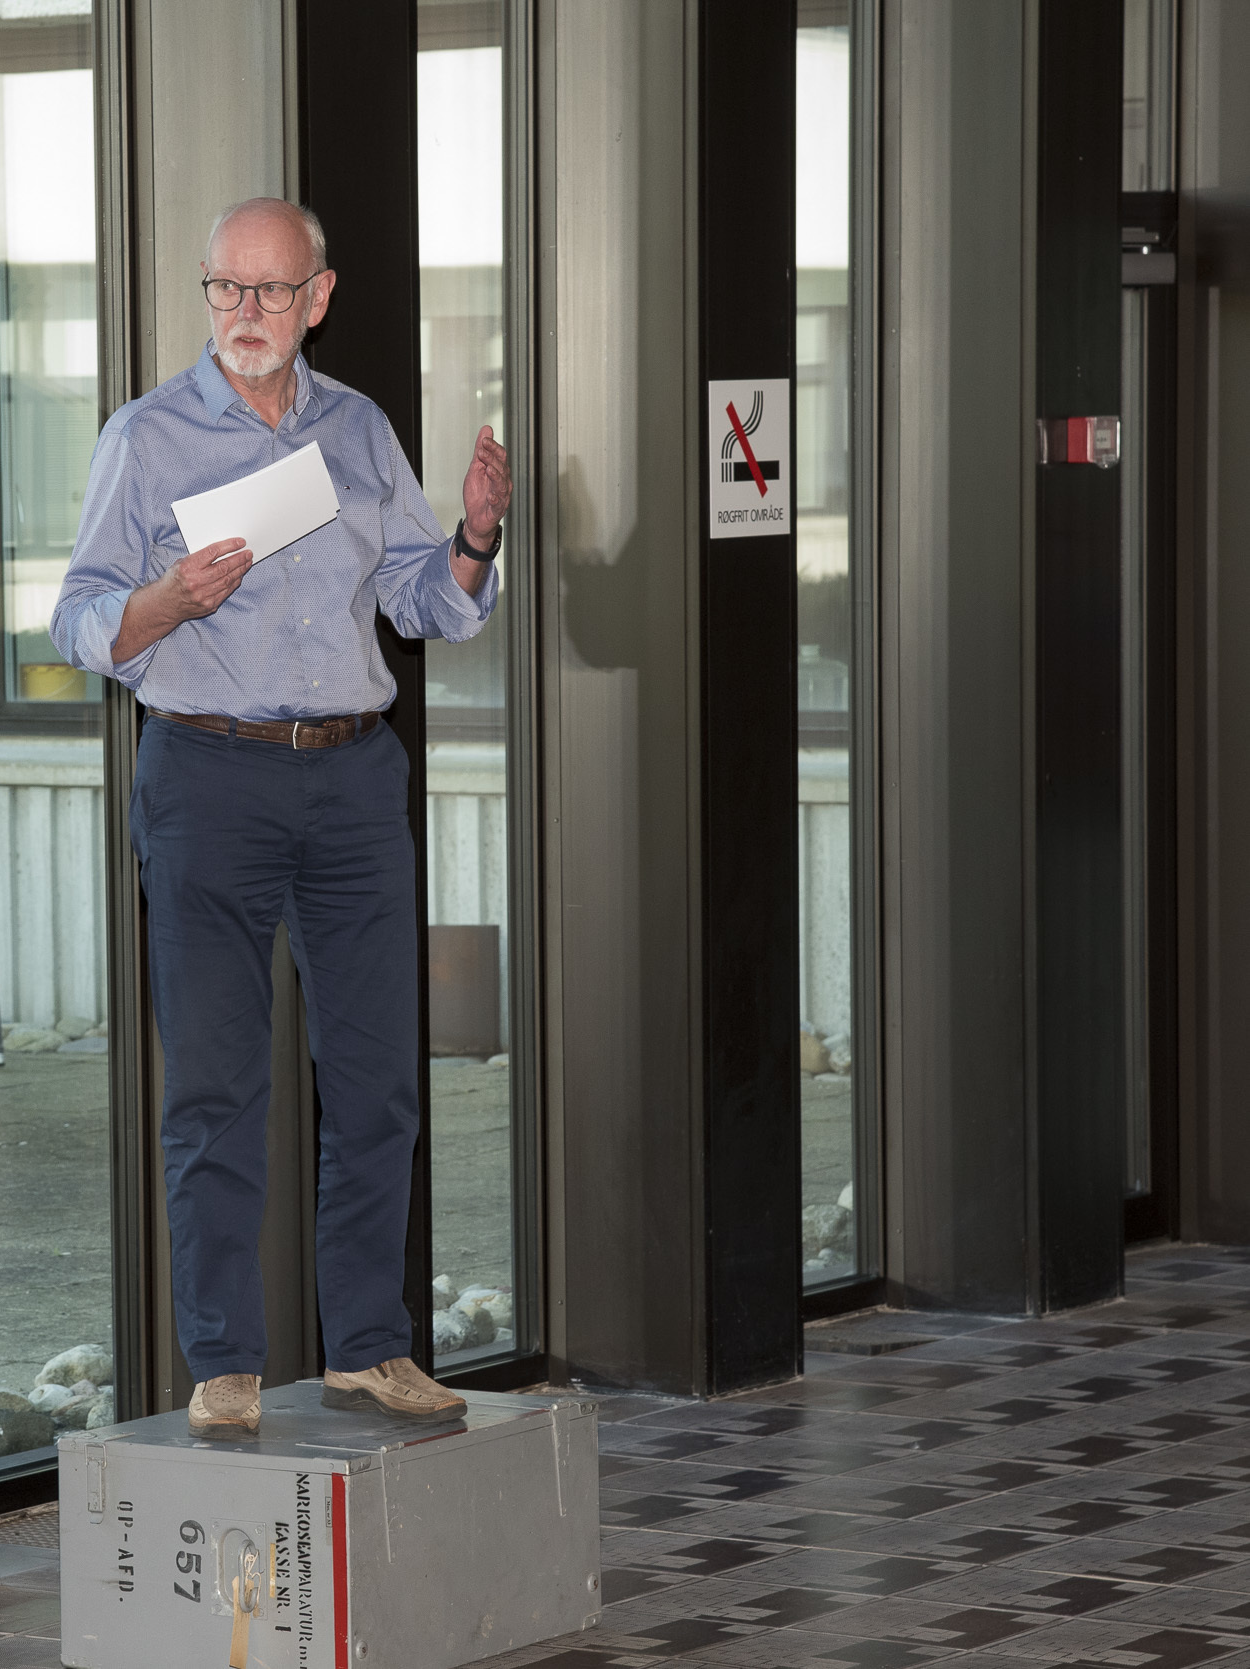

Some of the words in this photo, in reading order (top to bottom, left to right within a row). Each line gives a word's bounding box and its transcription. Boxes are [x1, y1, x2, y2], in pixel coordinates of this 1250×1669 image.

[718, 509, 749, 524] RØGFRIT
[750, 504, 784, 522] OMRÅDE
[174, 1519, 206, 1603] 657
[275, 1521, 290, 1577] KASSE
[296, 1473, 312, 1642] NARKOSEAPPARATUR
[276, 1585, 291, 1613] NR.
